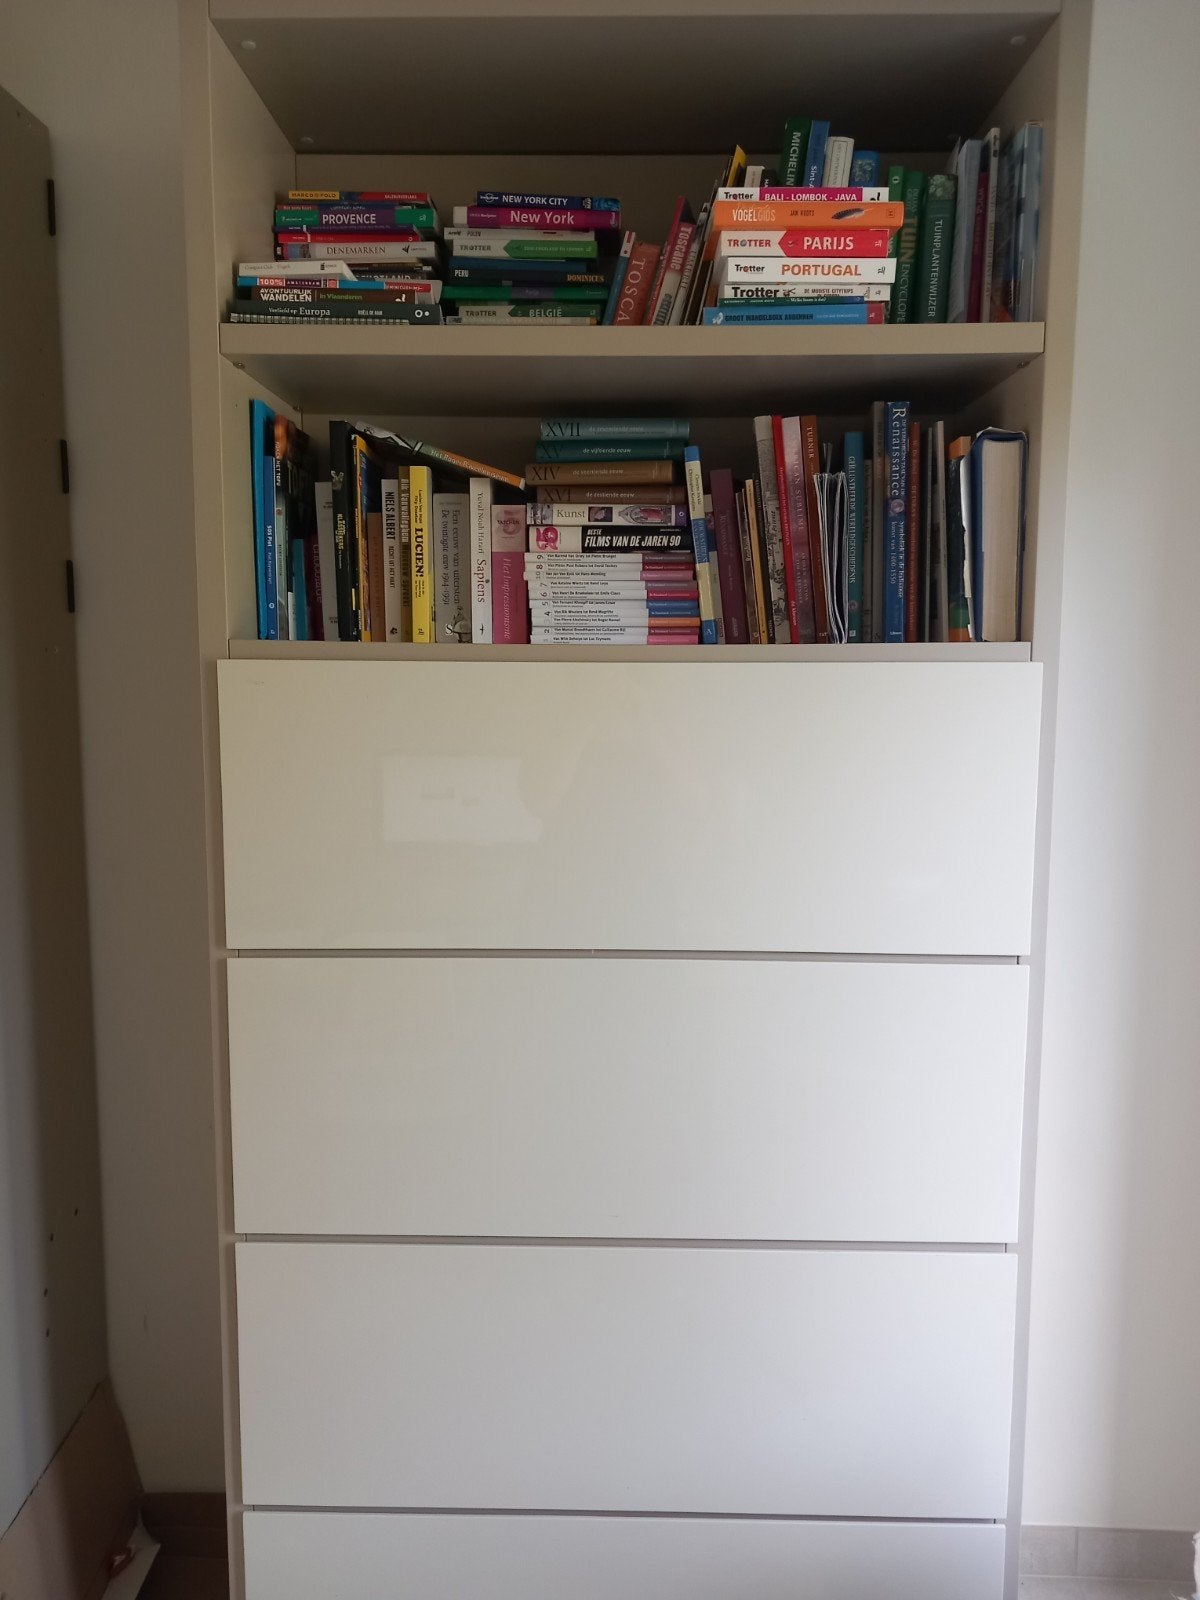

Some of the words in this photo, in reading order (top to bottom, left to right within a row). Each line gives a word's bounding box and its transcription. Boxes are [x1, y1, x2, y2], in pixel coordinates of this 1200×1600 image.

[785, 131, 802, 187] MICHELIN
[502, 195, 523, 204] NEW
[524, 196, 547, 206] YORK
[549, 197, 569, 206] CITY
[724, 191, 753, 200] Trotter
[764, 193, 786, 201] BALI
[791, 193, 827, 201] LOMBOK
[835, 193, 857, 201] JAVA
[322, 213, 377, 225] PROVENCE
[510, 210, 540, 223] New
[544, 211, 575, 225] York
[803, 236, 854, 250] PARIJS
[326, 246, 386, 255] DENEMARKEN
[454, 269, 469, 278] PERU
[735, 264, 765, 272] Trotter
[781, 264, 862, 276] PORTUGAL
[927, 219, 943, 317] TUINPLANTENWIJZER
[260, 277, 284, 286] 100%
[567, 274, 605, 283] DOMINICUS
[259, 287, 312, 295] AVONTUURLIJK
[617, 258, 646, 322] TOSCA
[732, 286, 780, 298] Trotter
[260, 294, 312, 303] WANDELEN
[299, 307, 331, 316] Europa
[724, 314, 744, 322] GROOT
[545, 422, 580, 437] XVII
[806, 426, 814, 459] TURNER
[540, 444, 563, 459] XV
[891, 407, 906, 496] Renaissance
[532, 466, 560, 480] XIV
[385, 491, 395, 512] NIELS
[544, 488, 571, 502] XVI
[452, 509, 460, 524] Een
[556, 509, 586, 518] Kunst
[385, 513, 396, 541] ALBERT
[584, 536, 611, 547] FILMS
[612, 536, 629, 547] VAN
[630, 536, 640, 547] DE
[641, 536, 668, 547] JAREN
[669, 535, 682, 547] 90
[414, 527, 424, 577] LUCIEN!
[503, 558, 511, 574] Het
[473, 558, 488, 603] Sapiens
